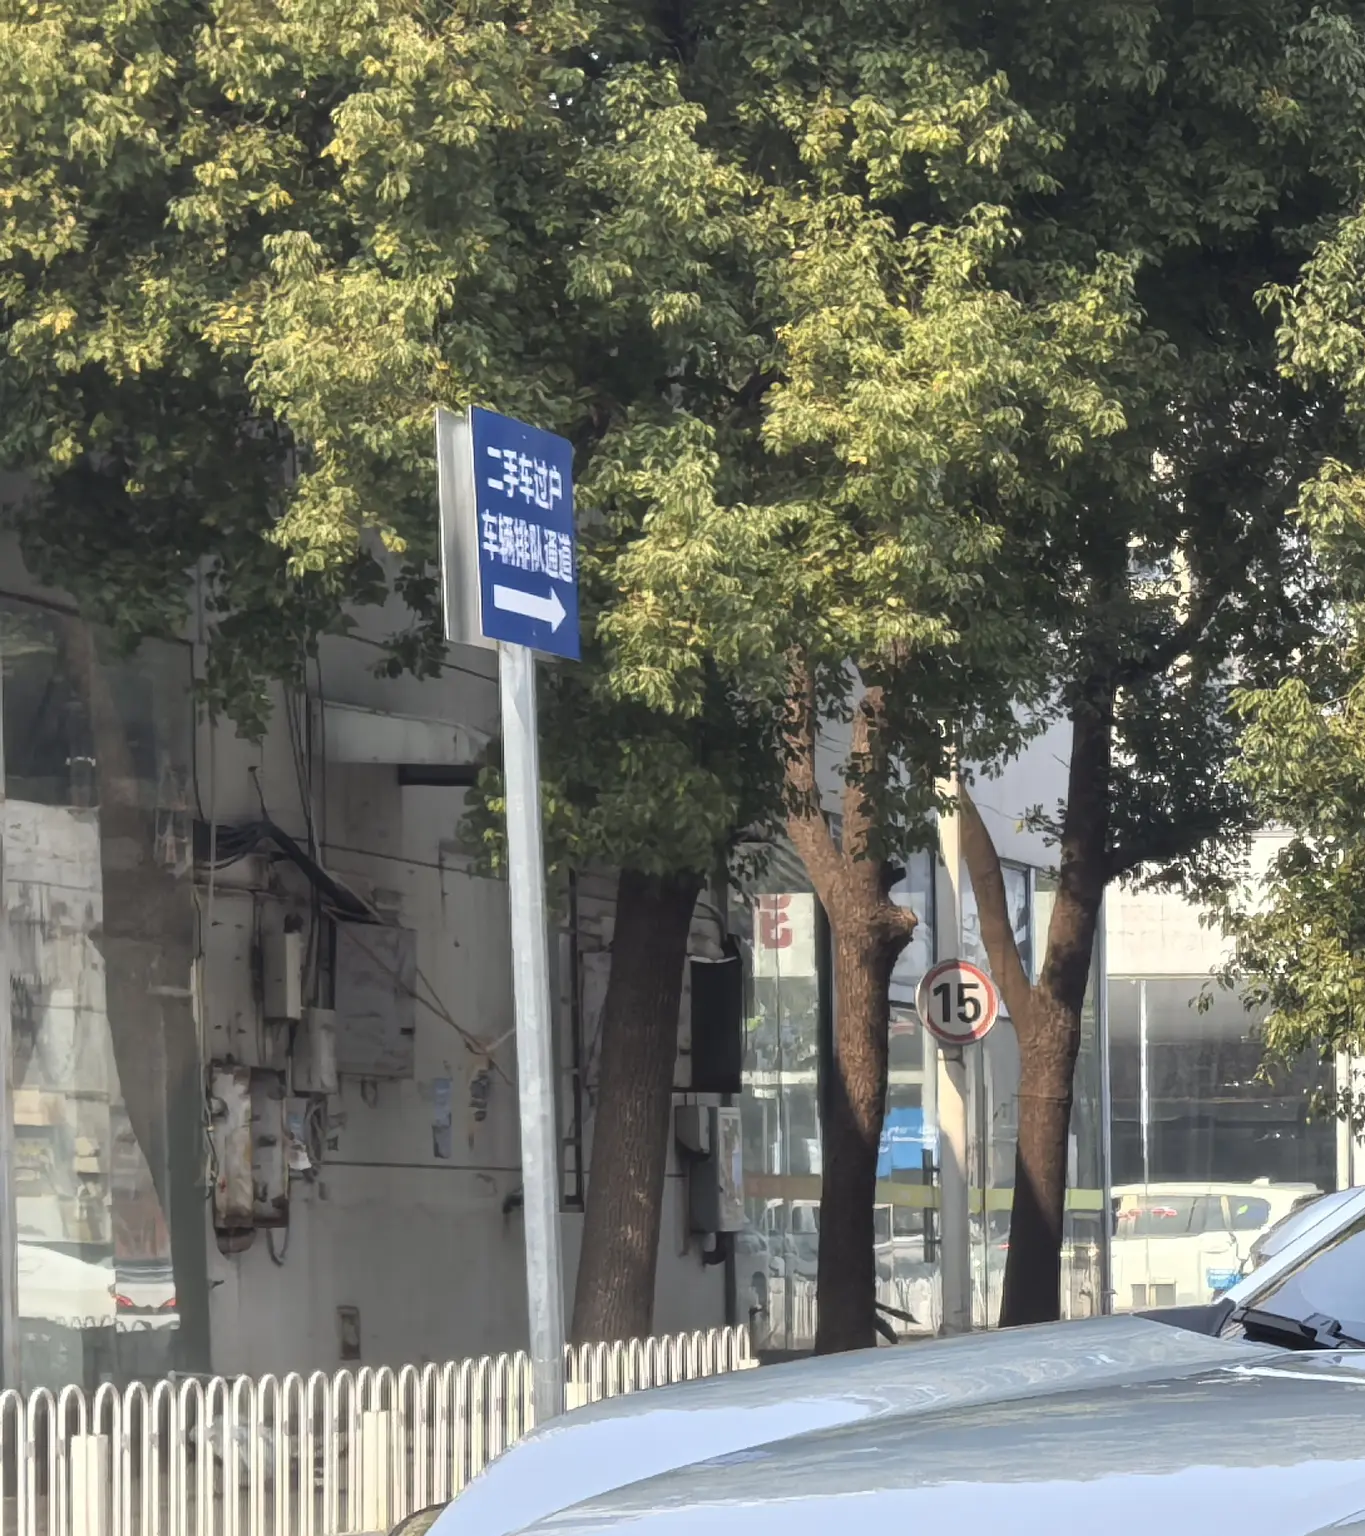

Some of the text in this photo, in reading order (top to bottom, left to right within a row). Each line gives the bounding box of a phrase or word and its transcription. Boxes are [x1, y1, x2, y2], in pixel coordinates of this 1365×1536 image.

[487, 446, 562, 510] 二手车过户
[933, 982, 981, 1023] 15
